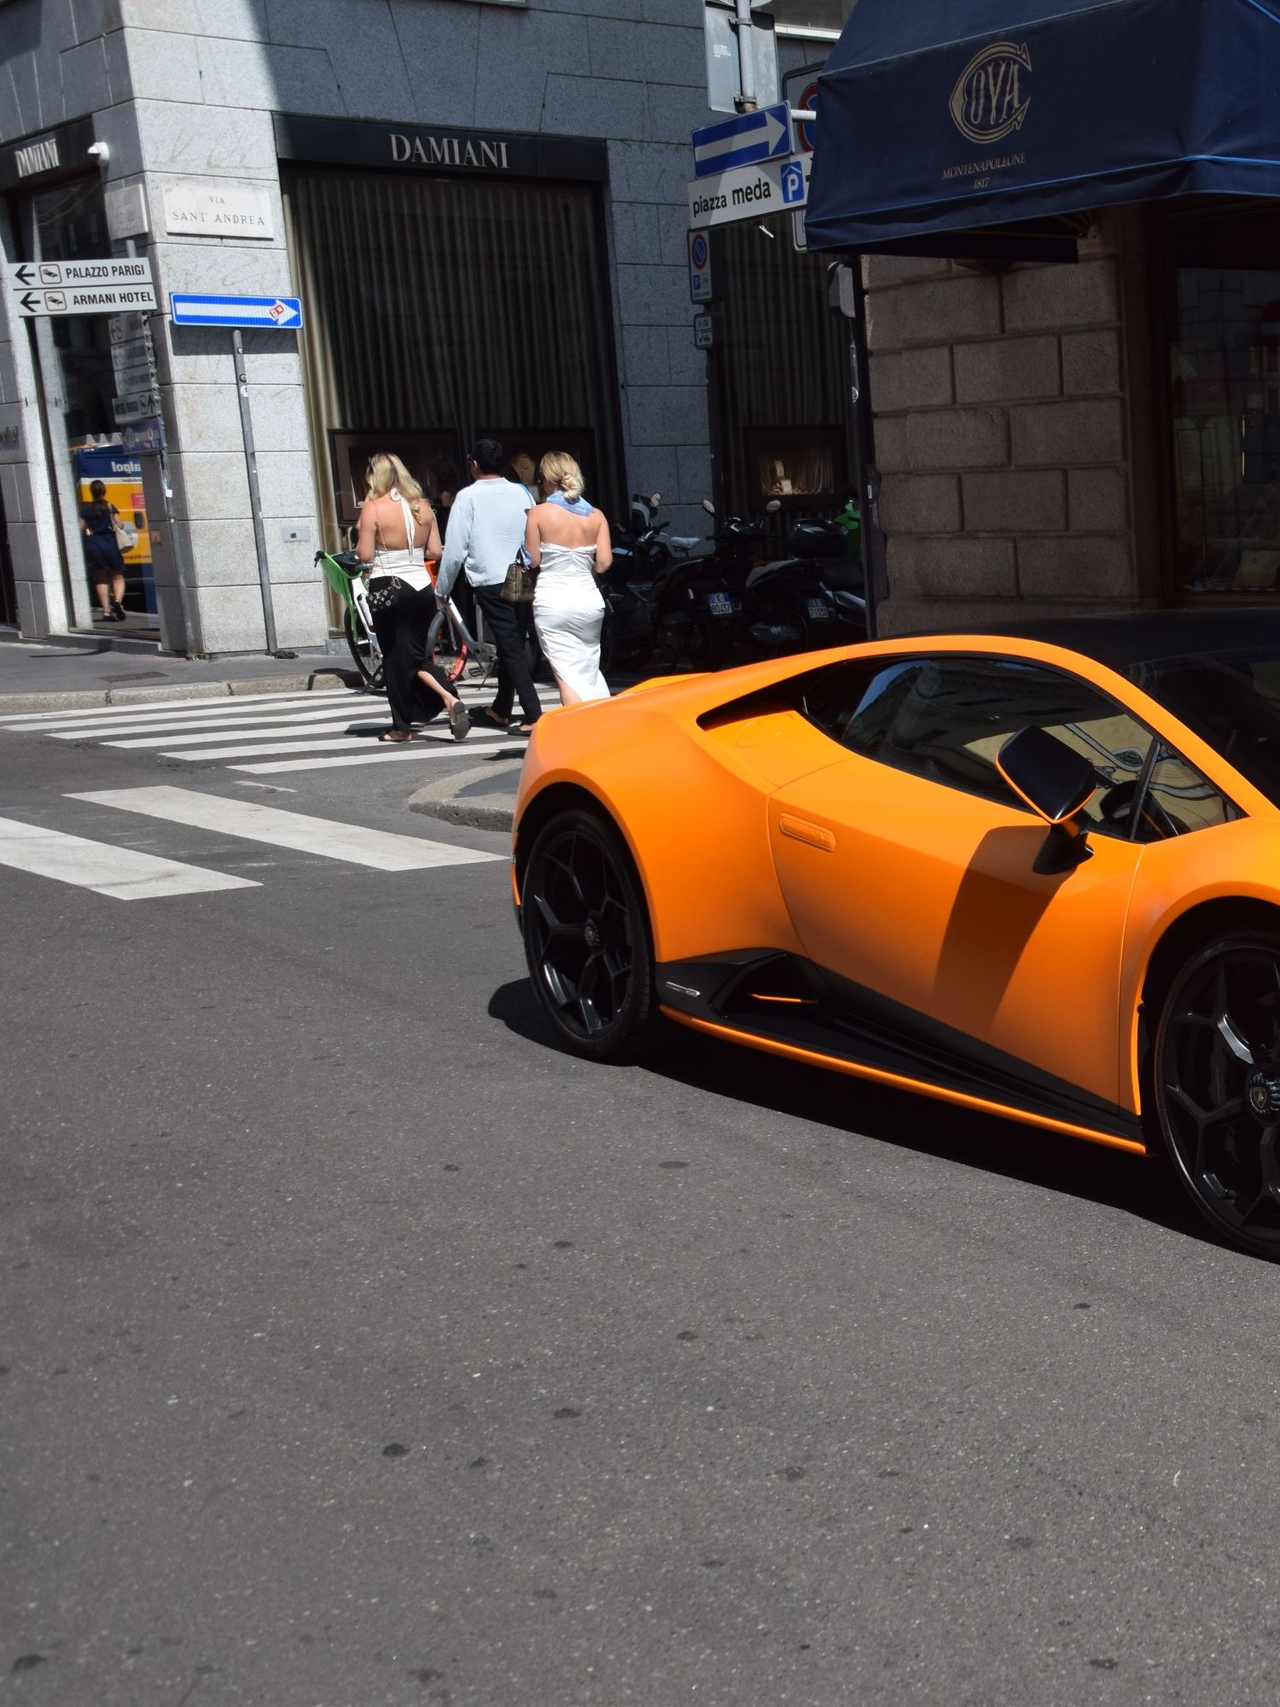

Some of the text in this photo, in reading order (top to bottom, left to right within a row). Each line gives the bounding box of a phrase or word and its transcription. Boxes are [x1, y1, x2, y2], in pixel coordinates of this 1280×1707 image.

[389, 133, 510, 168] DAMIANI
[942, 153, 1026, 180] MONTENAPOLEONE
[208, 196, 225, 204] VIA
[693, 193, 727, 217] piazza
[732, 177, 771, 206] meda
[214, 214, 265, 226] ANDREA
[65, 264, 145, 279] PALAZZO PARIGI
[73, 291, 154, 306] ARMANI HOTEL
